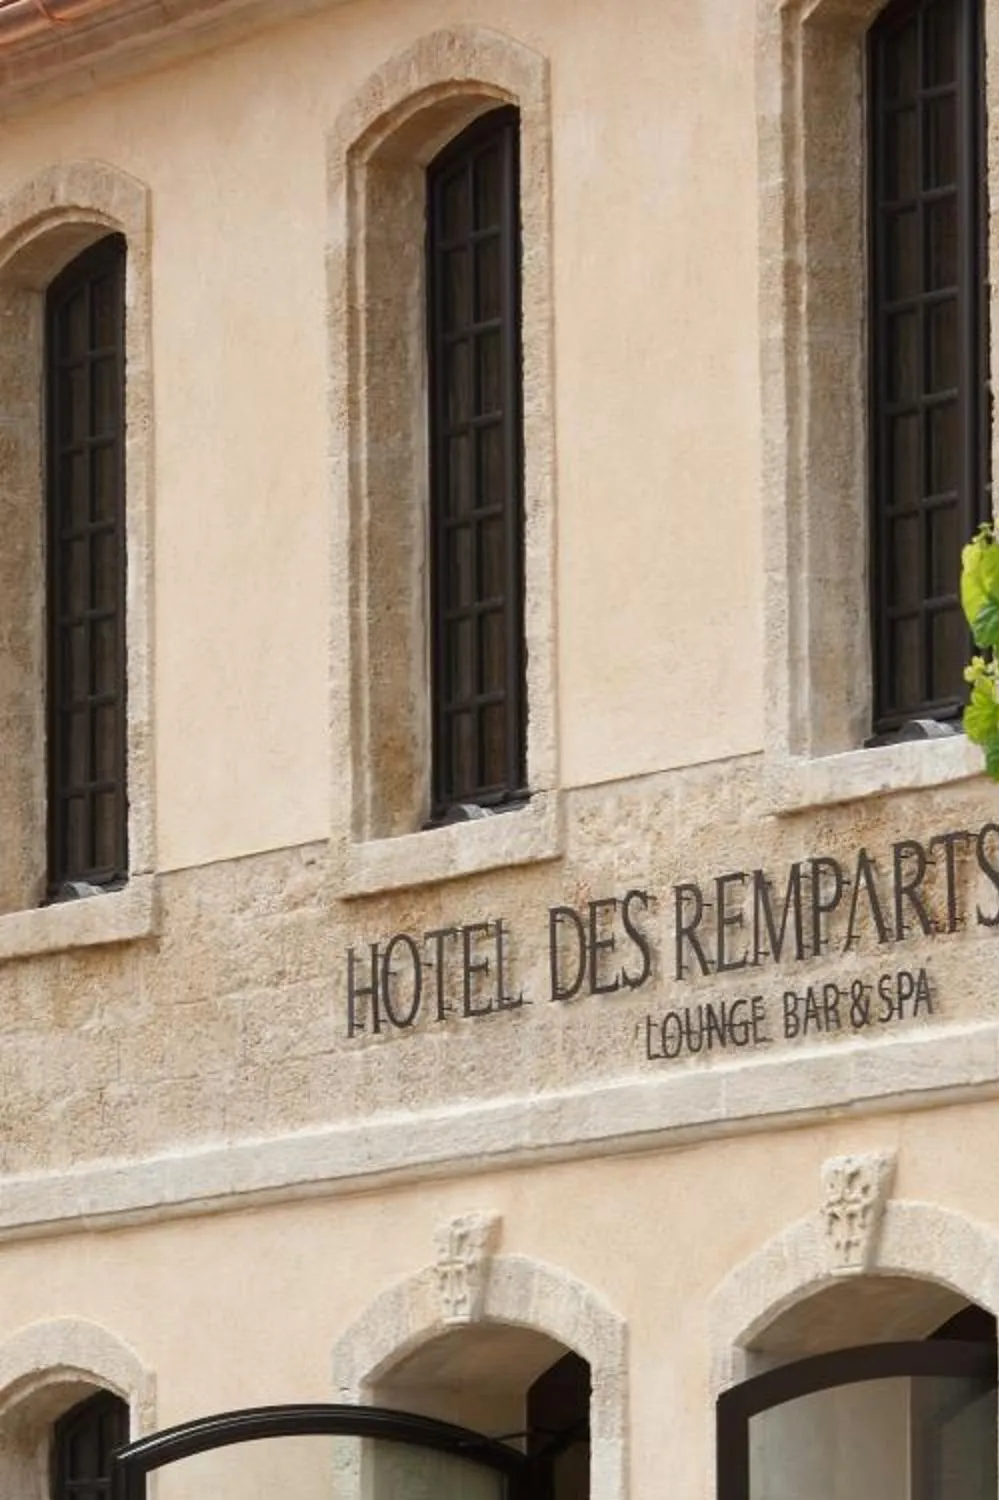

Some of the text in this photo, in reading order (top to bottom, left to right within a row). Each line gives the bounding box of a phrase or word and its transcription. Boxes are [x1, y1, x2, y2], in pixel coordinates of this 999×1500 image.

[347, 918, 525, 1038] HOTEL
[548, 891, 652, 1002] DES
[645, 996, 769, 1060] LOUNGE
